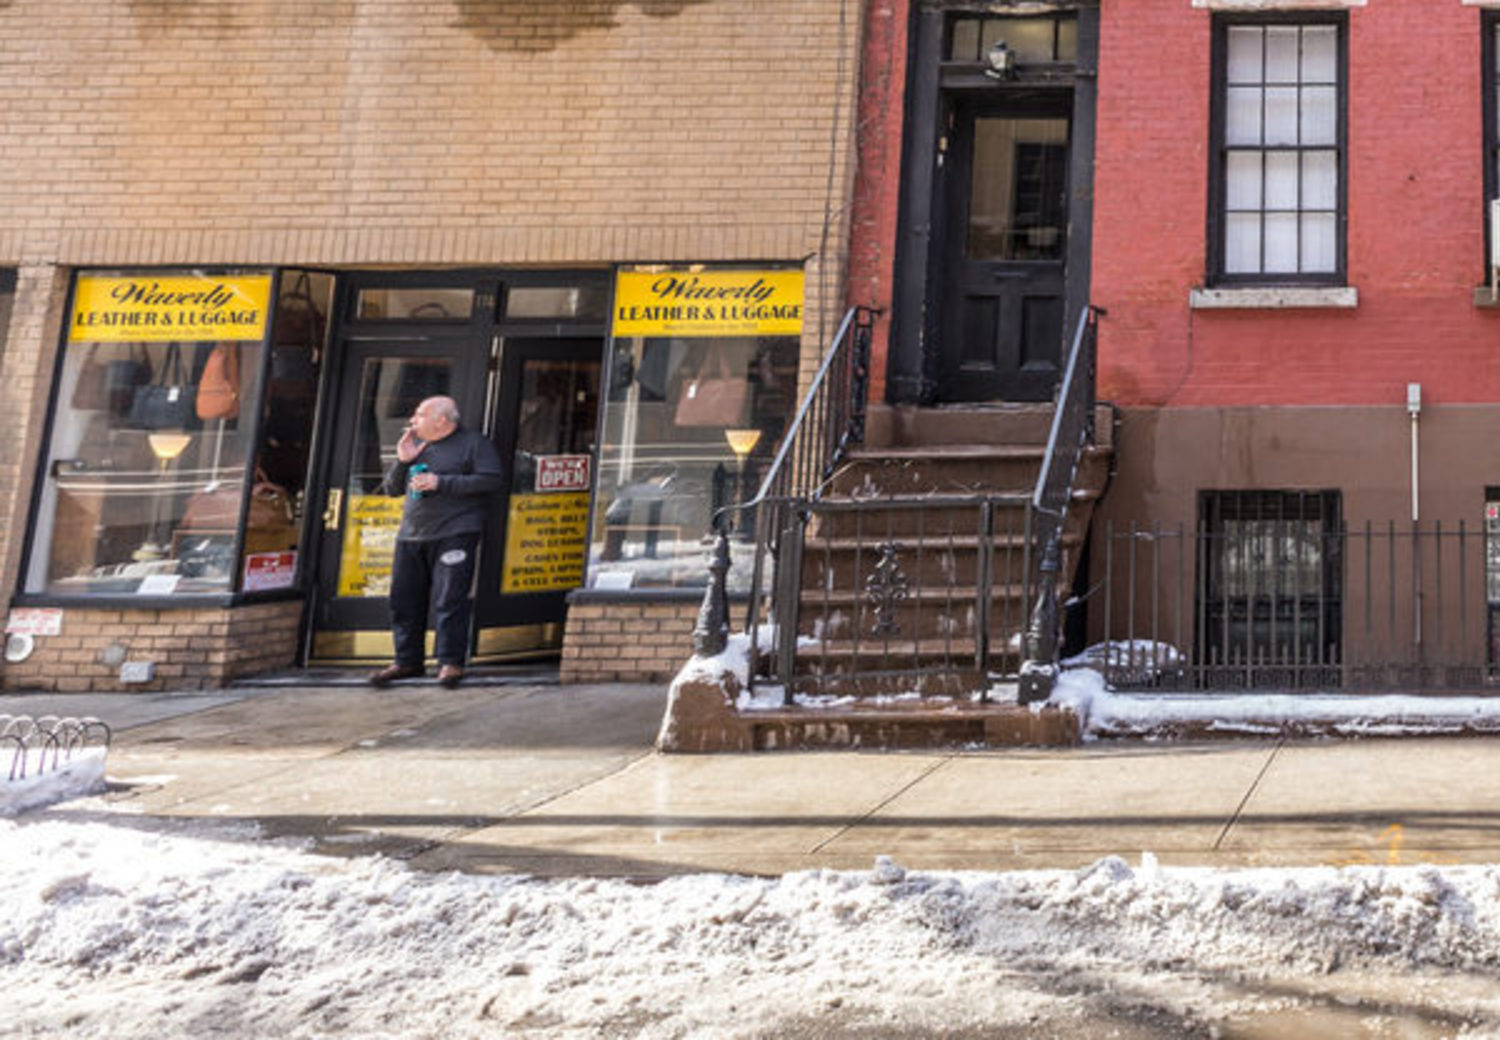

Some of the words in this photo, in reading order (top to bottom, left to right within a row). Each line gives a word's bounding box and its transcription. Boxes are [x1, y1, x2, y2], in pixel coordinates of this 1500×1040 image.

[111, 283, 235, 309] Waverly
[652, 277, 776, 303] Waverly
[76, 311, 156, 326] LEATHER
[160, 311, 172, 326] &
[178, 309, 260, 326] LUGGAGE
[619, 307, 699, 321] LEATHER
[702, 307, 715, 321] &
[720, 305, 802, 321] LUGGAGE
[542, 471, 584, 486] OPEN
